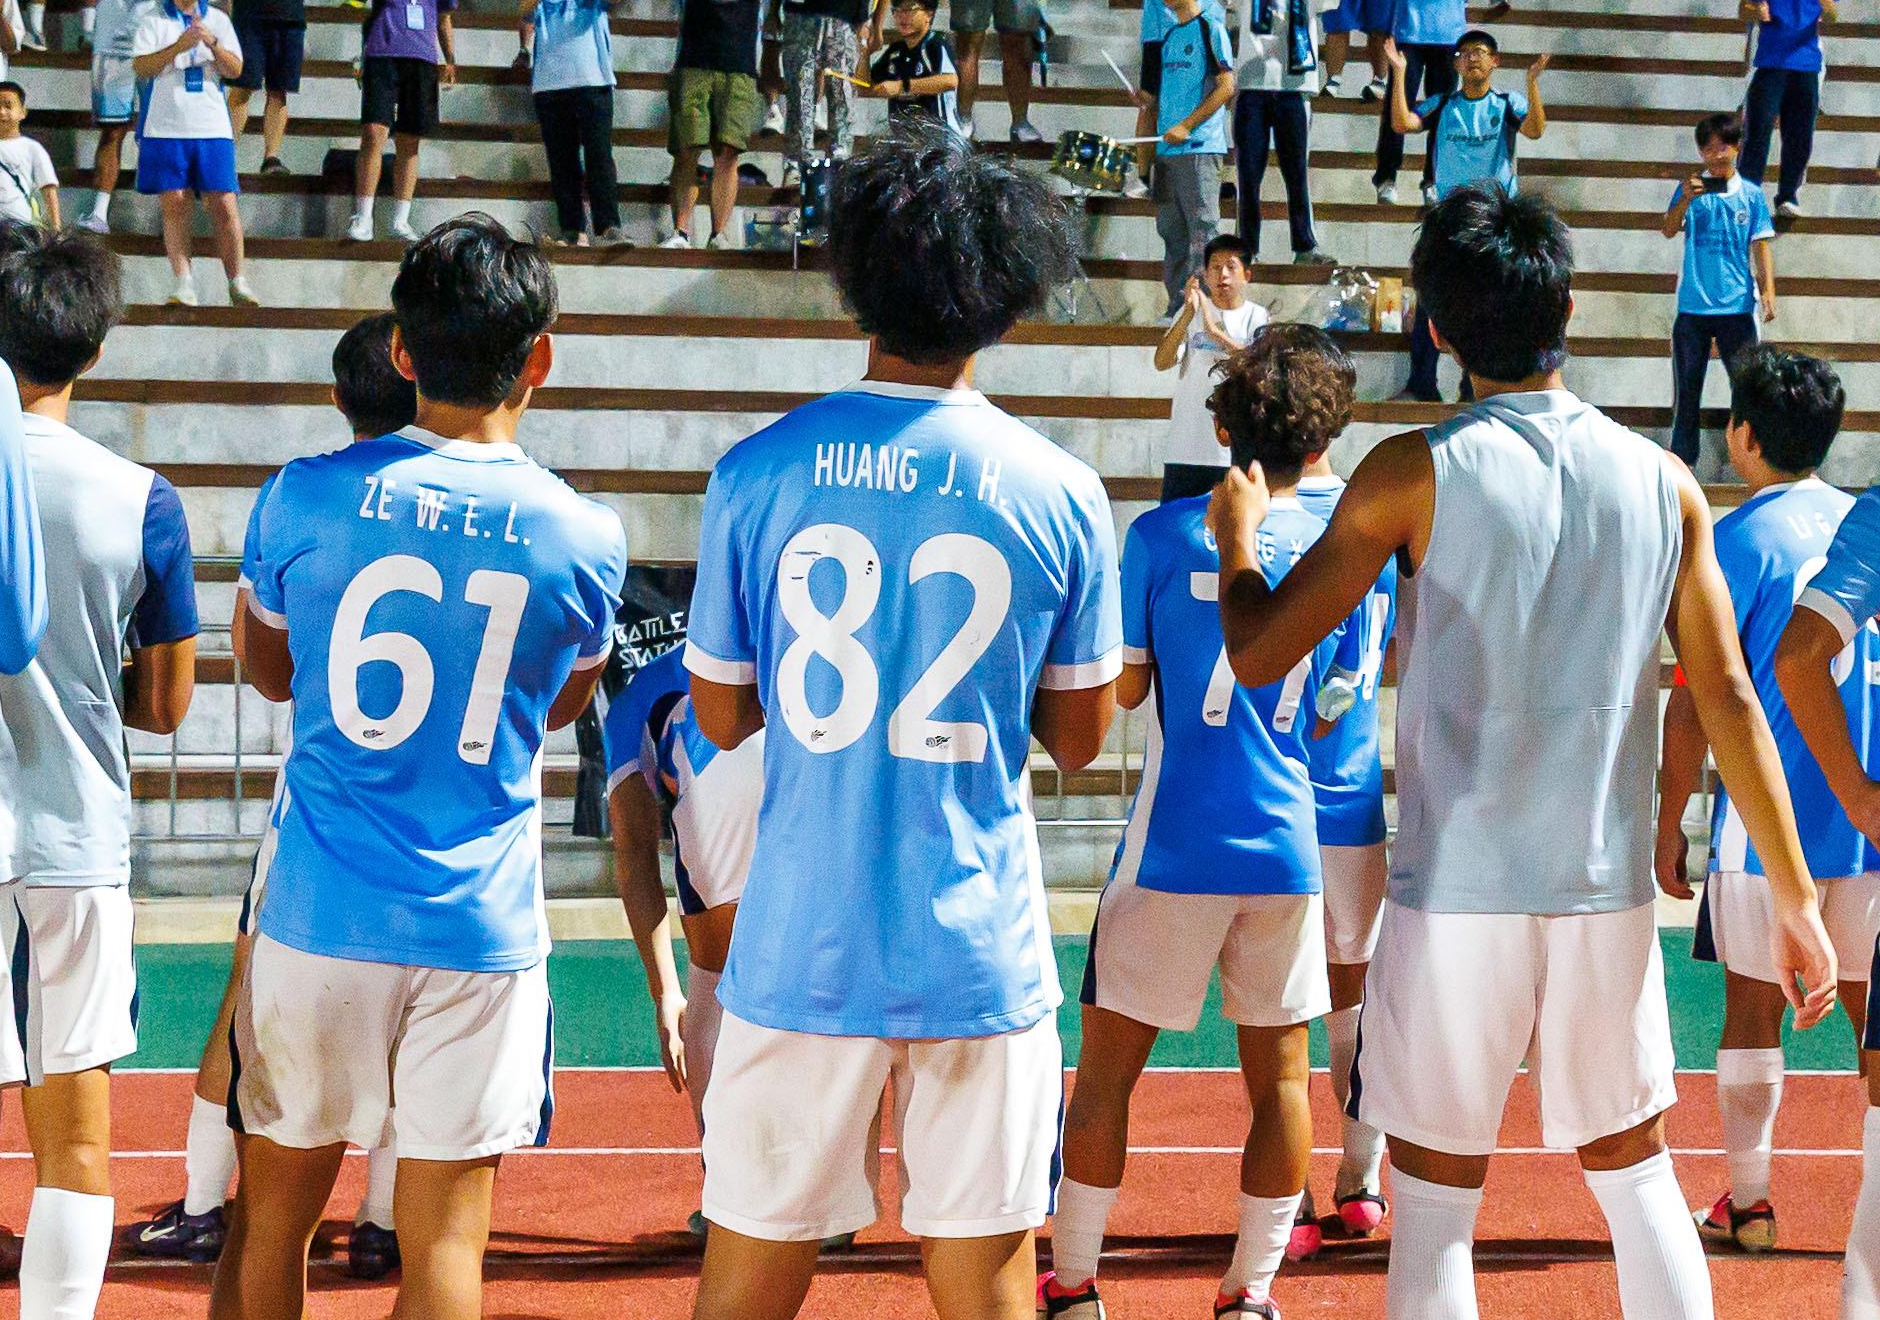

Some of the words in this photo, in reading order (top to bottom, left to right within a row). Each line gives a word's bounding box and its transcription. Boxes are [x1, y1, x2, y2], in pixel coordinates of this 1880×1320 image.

[359, 475, 396, 521] ZE
[815, 443, 919, 493] HUANG
[937, 452, 963, 498] J.
[977, 457, 1007, 507] H.
[327, 554, 530, 766] 61
[776, 523, 1013, 763] 82
